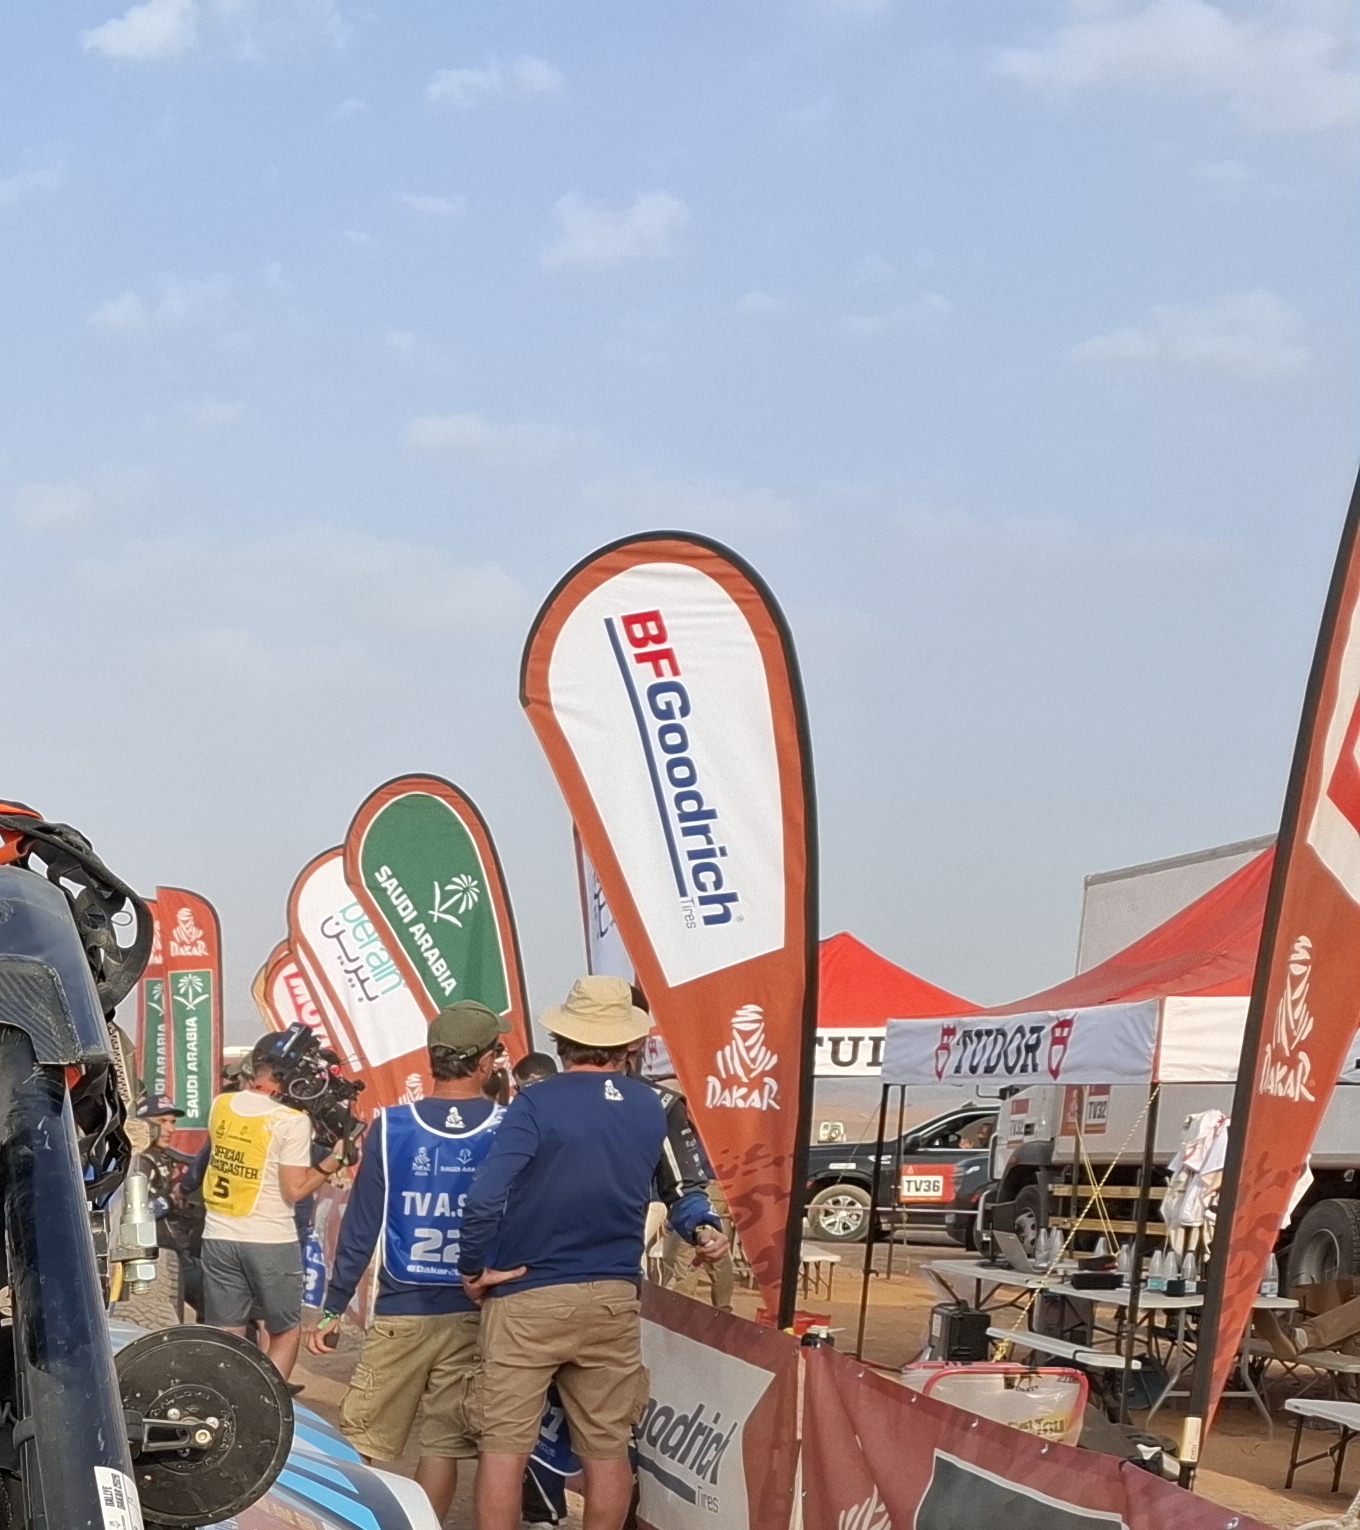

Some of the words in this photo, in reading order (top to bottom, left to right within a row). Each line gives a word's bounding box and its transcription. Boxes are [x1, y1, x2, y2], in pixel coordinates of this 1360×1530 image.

[621, 609, 739, 926] BFGoodrich
[375, 865, 417, 924] SAUDI
[409, 923, 457, 997] ARABIA
[681, 897, 696, 929] Tires
[170, 941, 209, 956] DAKAR
[187, 1016, 198, 1072] ARABIA
[954, 1025, 1045, 1075] TUDOR
[1260, 1043, 1315, 1101] DAKAR
[187, 1075, 198, 1118] SAUDI
[706, 1075, 780, 1111] DAKAR
[213, 1175, 230, 1199] 5
[905, 1179, 941, 1193] TV36
[696, 1486, 718, 1513] Tires
